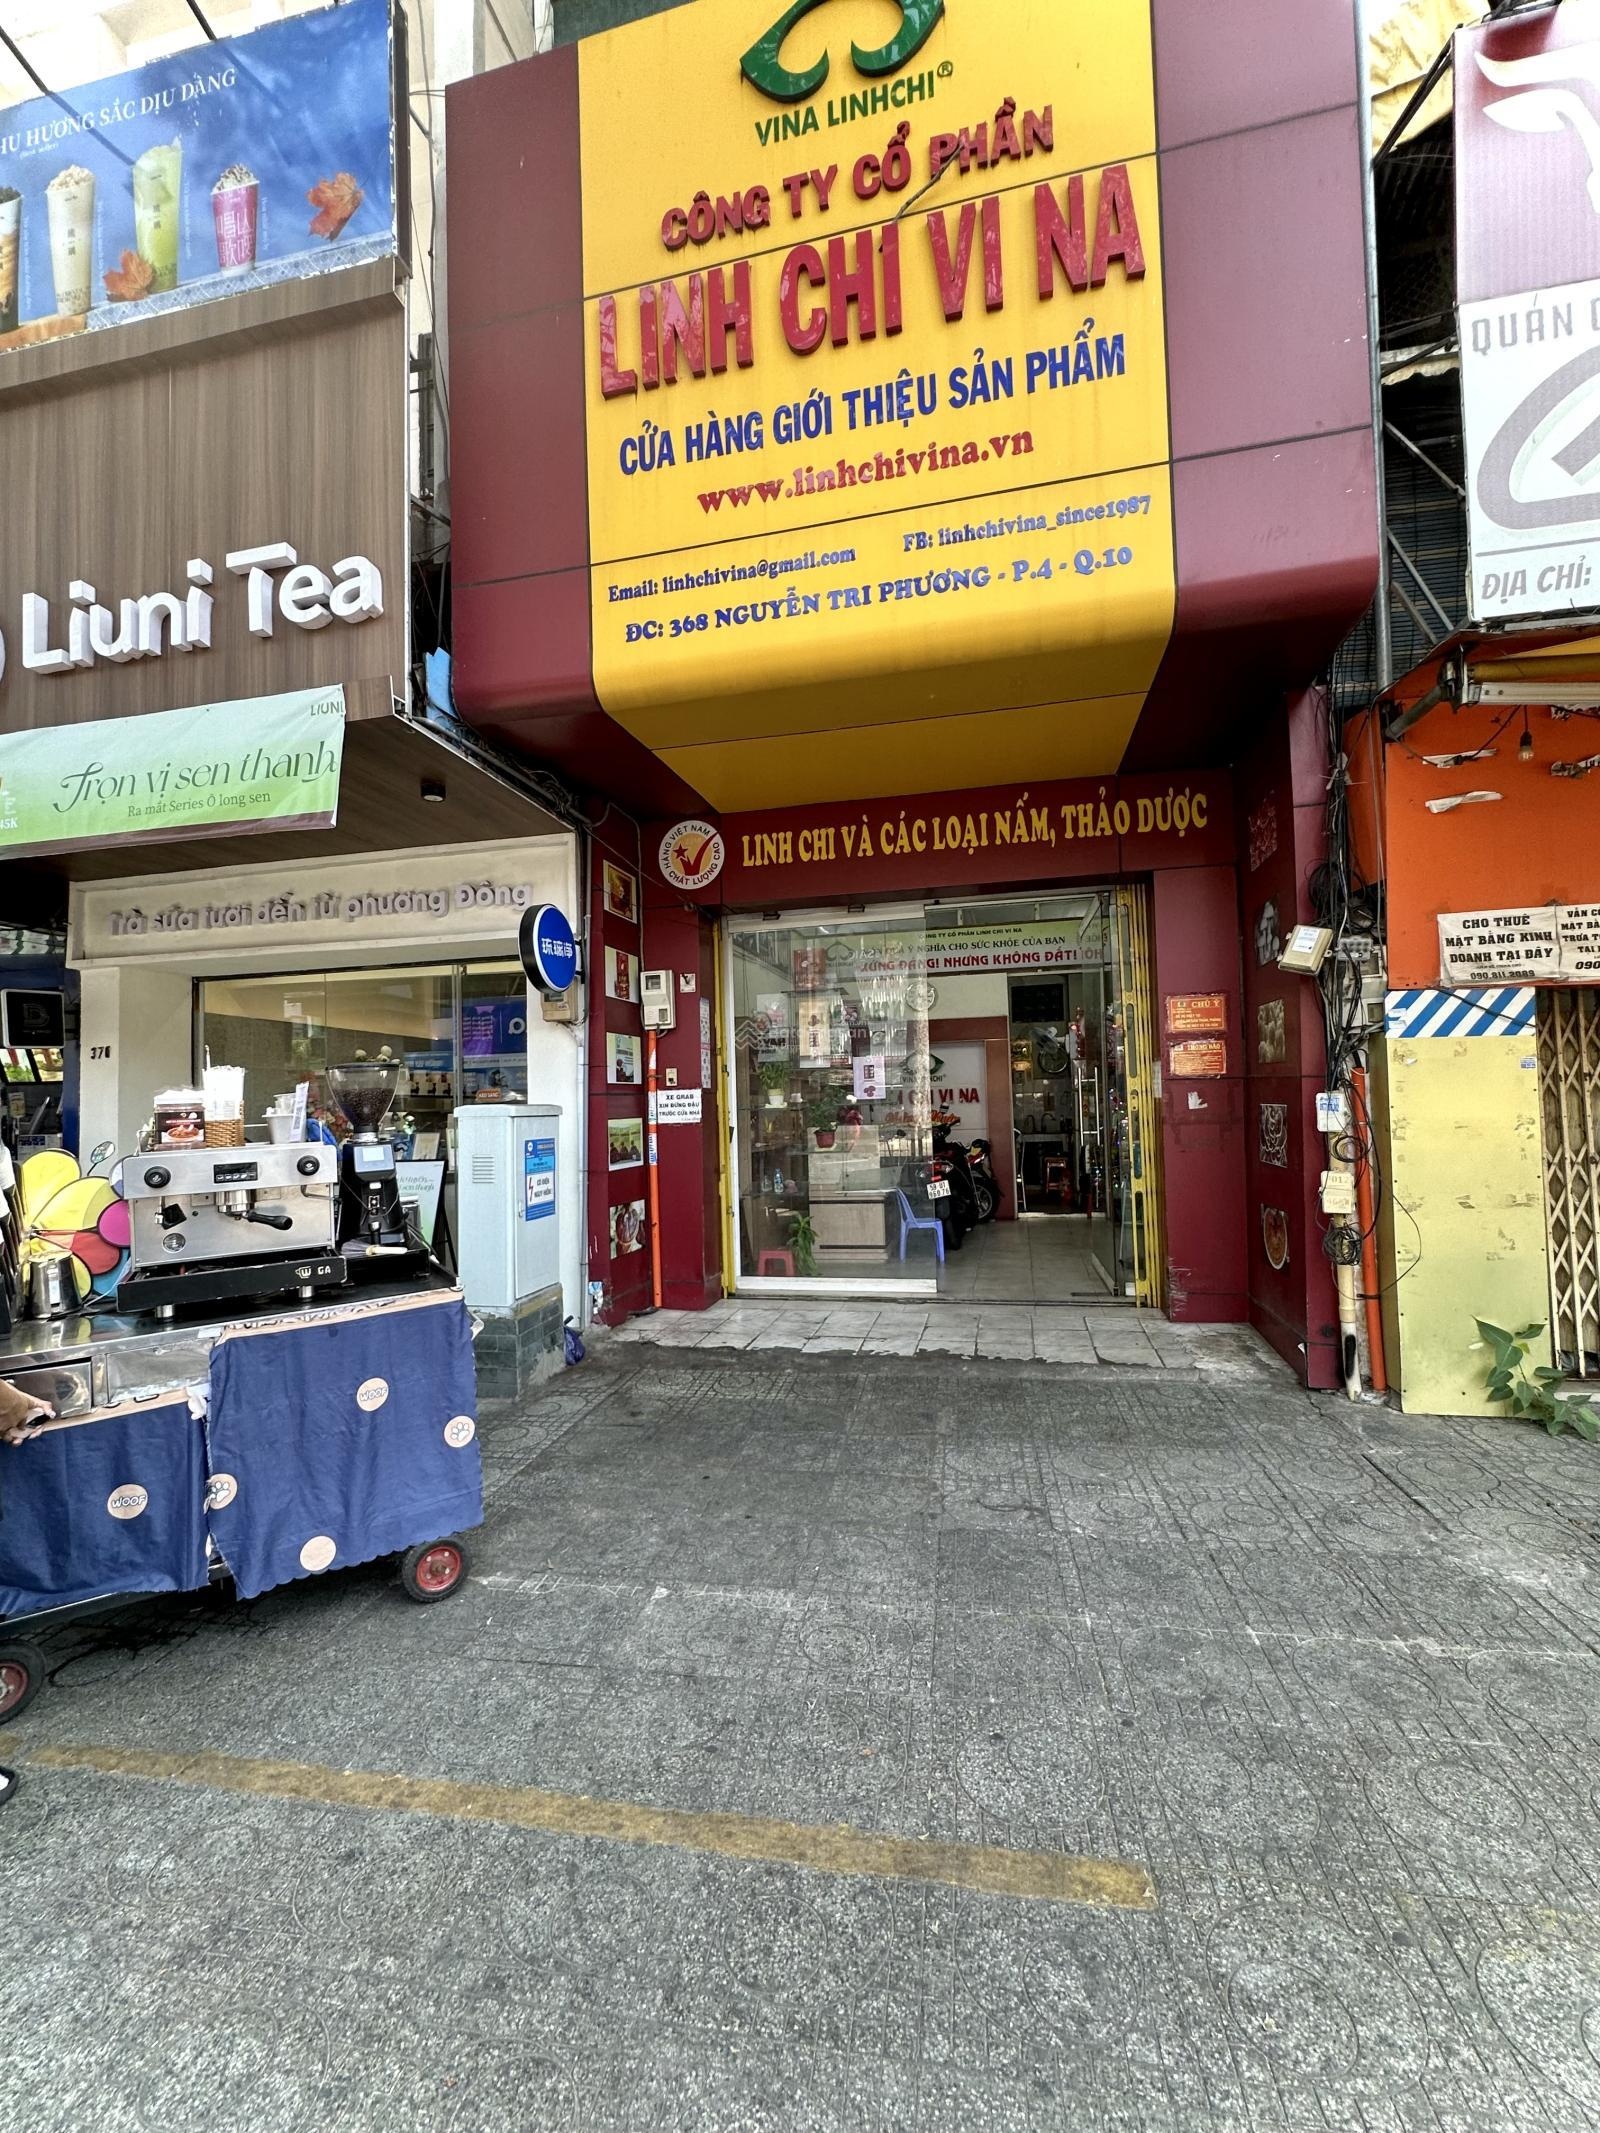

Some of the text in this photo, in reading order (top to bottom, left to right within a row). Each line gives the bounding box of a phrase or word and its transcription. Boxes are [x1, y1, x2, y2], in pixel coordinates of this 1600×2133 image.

[25, 112, 97, 146] HƯƠNG
[99, 97, 136, 127] SẮC
[140, 88, 176, 116] DỊU
[754, 107, 819, 147] VINA
[661, 97, 1054, 250] CÔNG TY CỔ PHẦN
[600, 260, 754, 400] LINH
[927, 196, 1004, 322] VI
[1034, 164, 1146, 300] NA
[1472, 293, 1573, 356] QUÁN
[619, 317, 1126, 476] CỬA HÀNG GIỚI THIỆU SẢN PHẨM
[697, 427, 1034, 514] www.linhchivina.vn
[903, 495, 1151, 552] FB: linhchivina_since1987
[608, 548, 856, 602] Email: linhchivina@gmail.com
[626, 620, 664, 642] ĐC:
[669, 613, 709, 638] 368
[715, 586, 821, 628] NGUYỄN
[827, 585, 872, 611] TRI
[878, 566, 991, 602] PHƯƠNG
[1012, 558, 1053, 582] P.4
[1074, 547, 1133, 575] Q.10
[1481, 555, 1592, 604] ĐỊA CHỈ:
[22, 541, 384, 674] Liuni Tea
[53, 762, 136, 813] Trọn
[147, 763, 171, 798] vị
[175, 761, 230, 790] sen
[240, 741, 337, 783] thanh
[128, 792, 271, 817] Ra mắt Series Ô long sen
[741, 786, 1208, 867] LINH CHI VÀ CÁC LOẠI NẤM, THẢO DƯỢC
[661, 824, 711, 869] HÀNG VIỆT NAM
[693, 862, 718, 885] LƯỢNG
[712, 842, 721, 861] CAO
[109, 905, 148, 936] Trà
[151, 903, 200, 932] sữa
[203, 902, 252, 930] tươi
[345, 888, 449, 922] phương
[454, 880, 532, 912] Đông
[1462, 914, 1530, 929] CHO THUÊ
[943, 953, 989, 967] NHƯNG
[993, 949, 1040, 964] KHÔNG
[1044, 947, 1078, 962] ĐẮT!
[949, 941, 968, 950] CHO
[971, 936, 991, 949] SỨC
[1022, 935, 1042, 947] CỦA
[1045, 935, 1065, 946] BẠN
[1445, 931, 1553, 949] MẶT BẰNG KINH
[1450, 946, 1553, 963] DOANH TẠI ĐÂY
[1562, 933, 1589, 942] TRƯA
[1577, 945, 1595, 955] TẠI
[959, 1087, 980, 1103] NA
[360, 1386, 387, 1402] WOOF
[111, 1494, 147, 1508] WOOF
